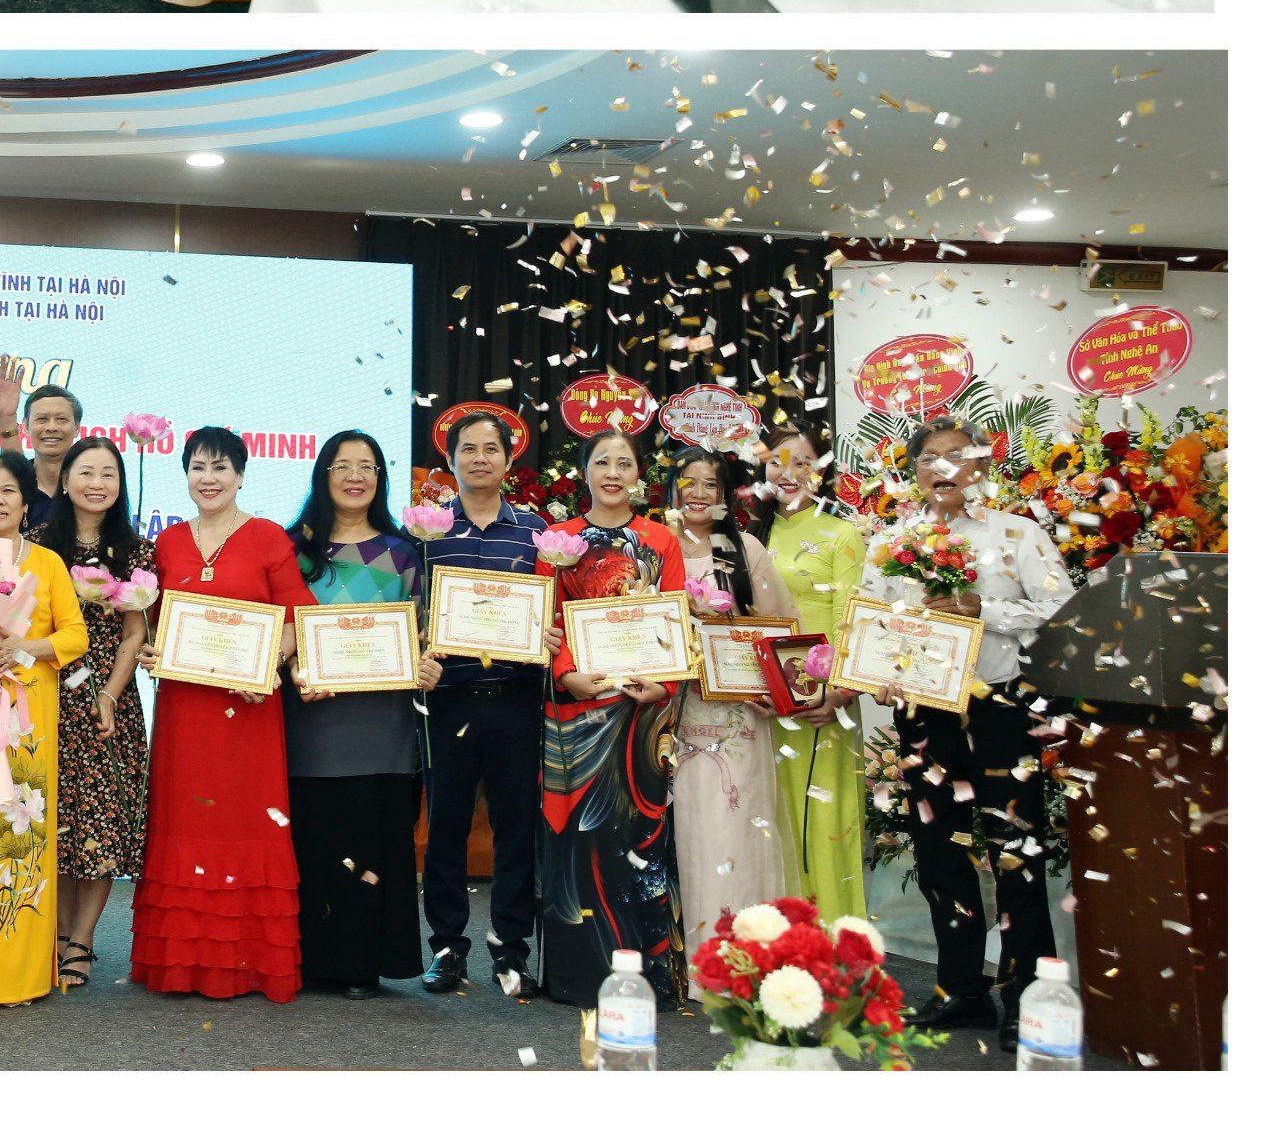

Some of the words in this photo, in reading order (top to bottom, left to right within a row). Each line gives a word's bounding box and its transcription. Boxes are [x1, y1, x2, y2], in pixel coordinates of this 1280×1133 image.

[37, 275, 62, 296] TẠI
[69, 274, 91, 295] HÀ
[97, 276, 126, 299] NỘI
[15, 301, 41, 322] TẠI
[47, 300, 69, 320] HÀ
[75, 301, 104, 325] NỘI
[243, 432, 316, 460] MINH
